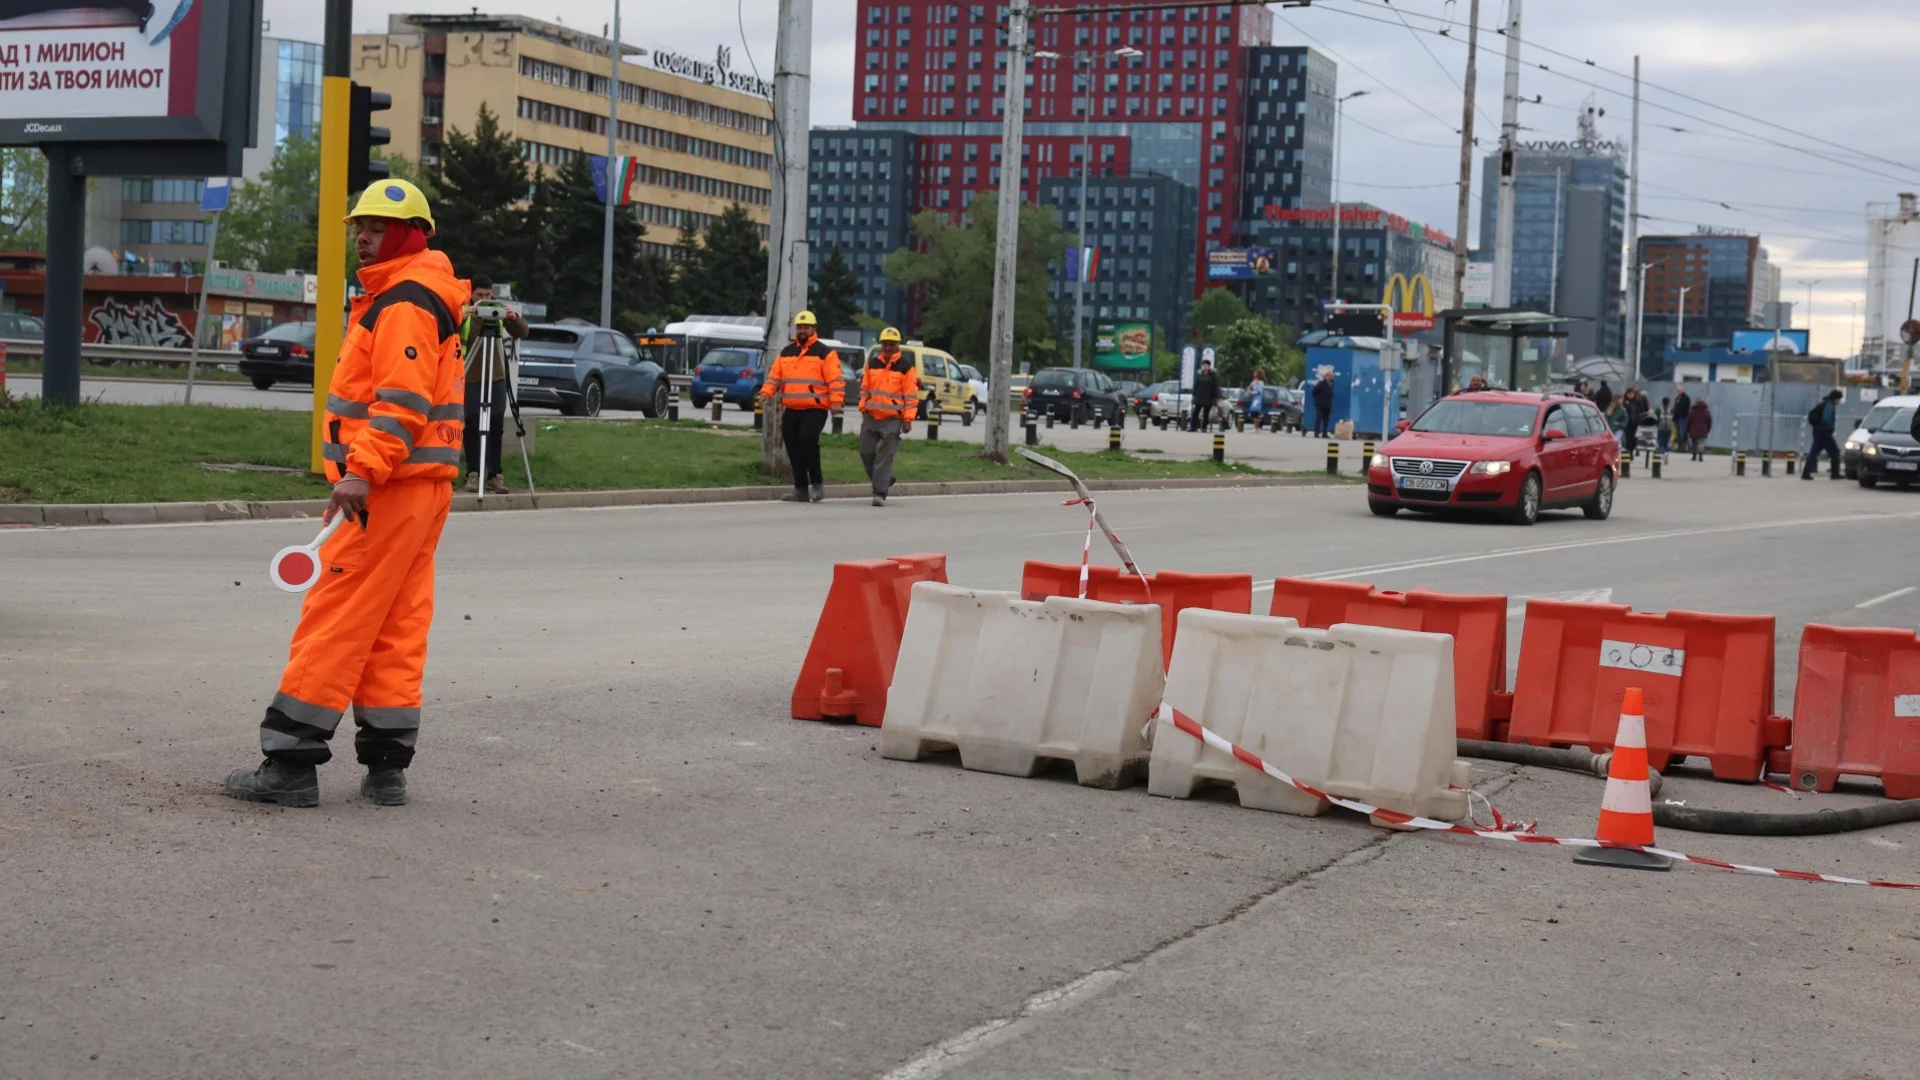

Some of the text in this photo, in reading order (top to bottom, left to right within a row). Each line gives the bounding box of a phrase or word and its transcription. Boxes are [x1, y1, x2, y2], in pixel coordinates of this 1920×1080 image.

[24, 43, 31, 63] 1
[37, 41, 125, 63] МИЛИОН
[0, 68, 164, 91] ТИ ЗА ТВОЯ ИМОТ
[24, 122, 62, 132] JCDecaux
[1525, 140, 1615, 151] VIVACOM
